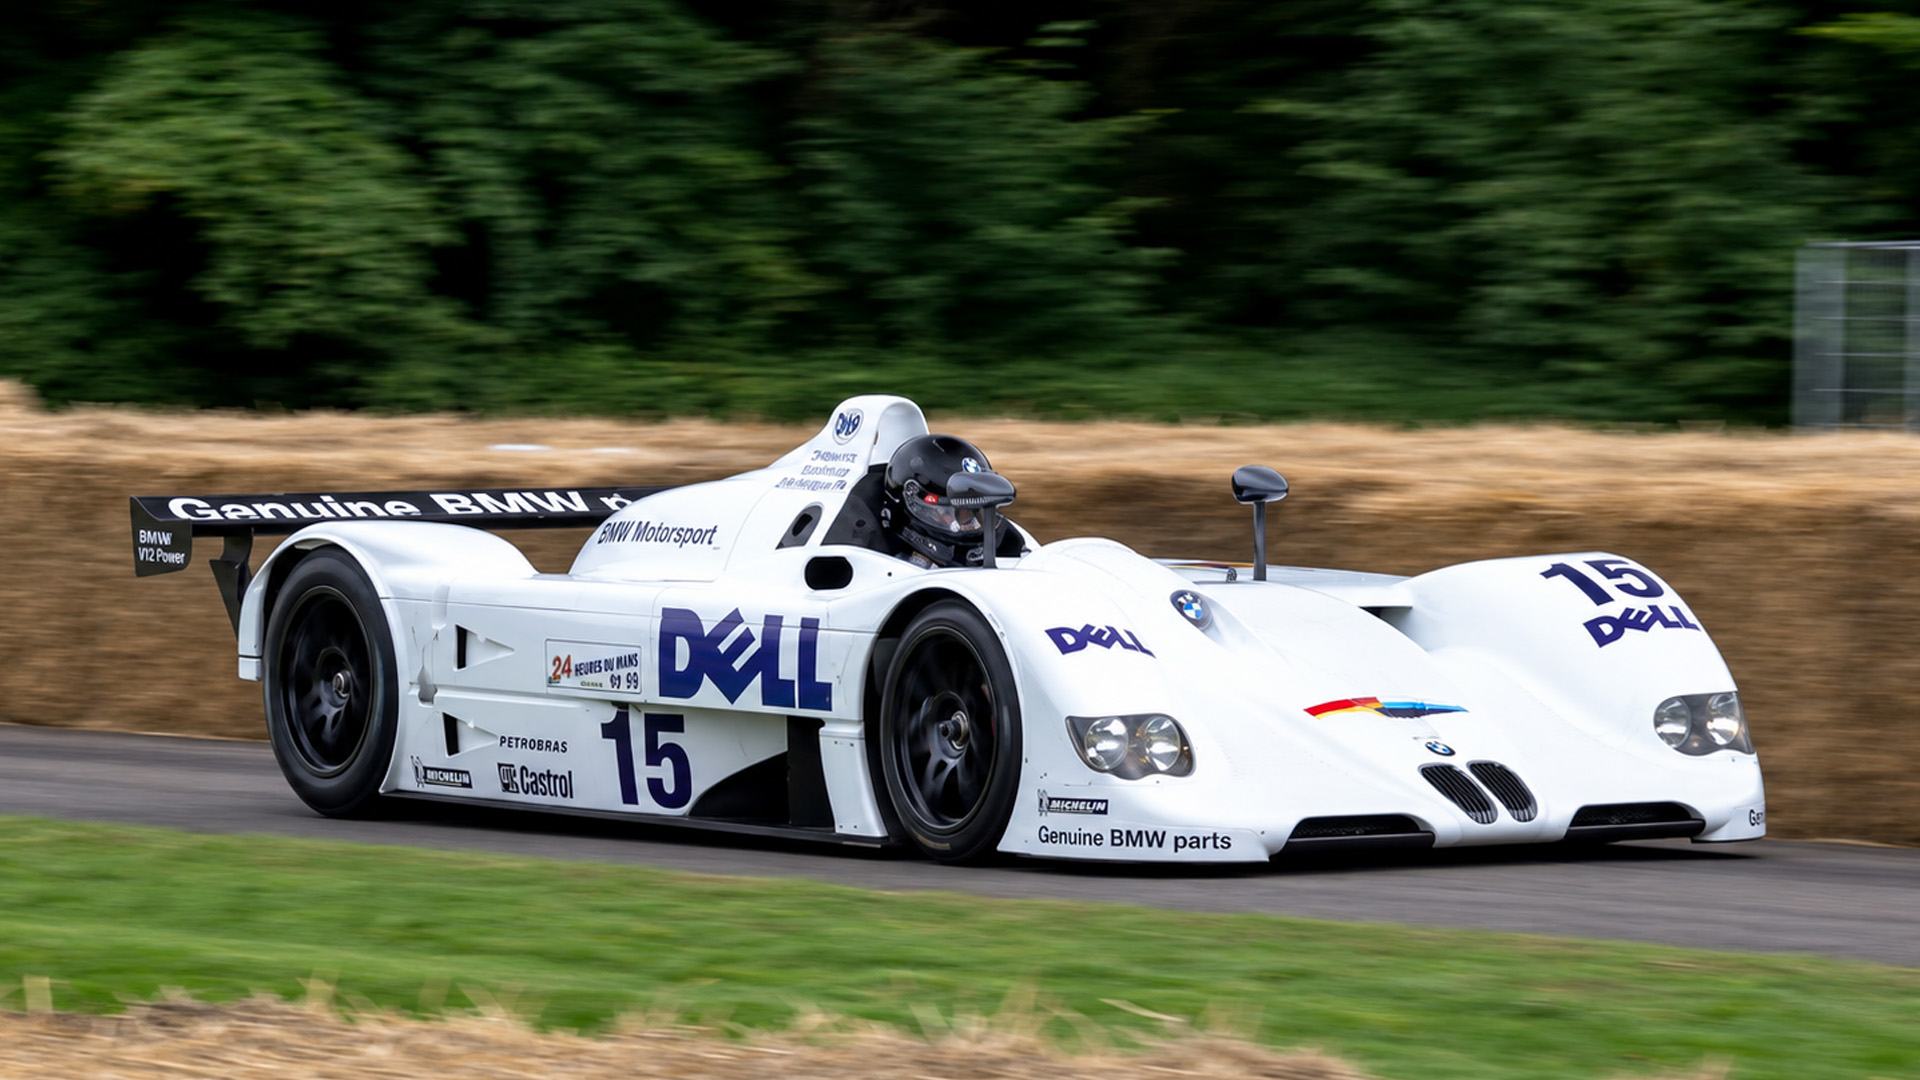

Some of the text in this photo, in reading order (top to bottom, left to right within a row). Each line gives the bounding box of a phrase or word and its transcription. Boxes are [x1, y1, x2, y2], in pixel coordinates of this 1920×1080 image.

[168, 495, 422, 520] Genuine
[429, 491, 590, 514] BMW
[139, 529, 172, 545] BMW
[597, 521, 718, 548] BMW Motorsport
[138, 547, 185, 564] V12 Power
[1540, 559, 1664, 606] 15
[1045, 623, 1156, 658] DELL
[1583, 605, 1701, 648] DELL
[552, 654, 572, 680] 24
[604, 657, 614, 672] DU
[659, 607, 832, 711] DELL
[500, 735, 568, 753] PETROBRAS
[600, 707, 692, 809] 15
[520, 766, 573, 798] Castrol
[1050, 799, 1106, 812] MICHELIN
[1038, 826, 1232, 852] Genuine BMW parts
